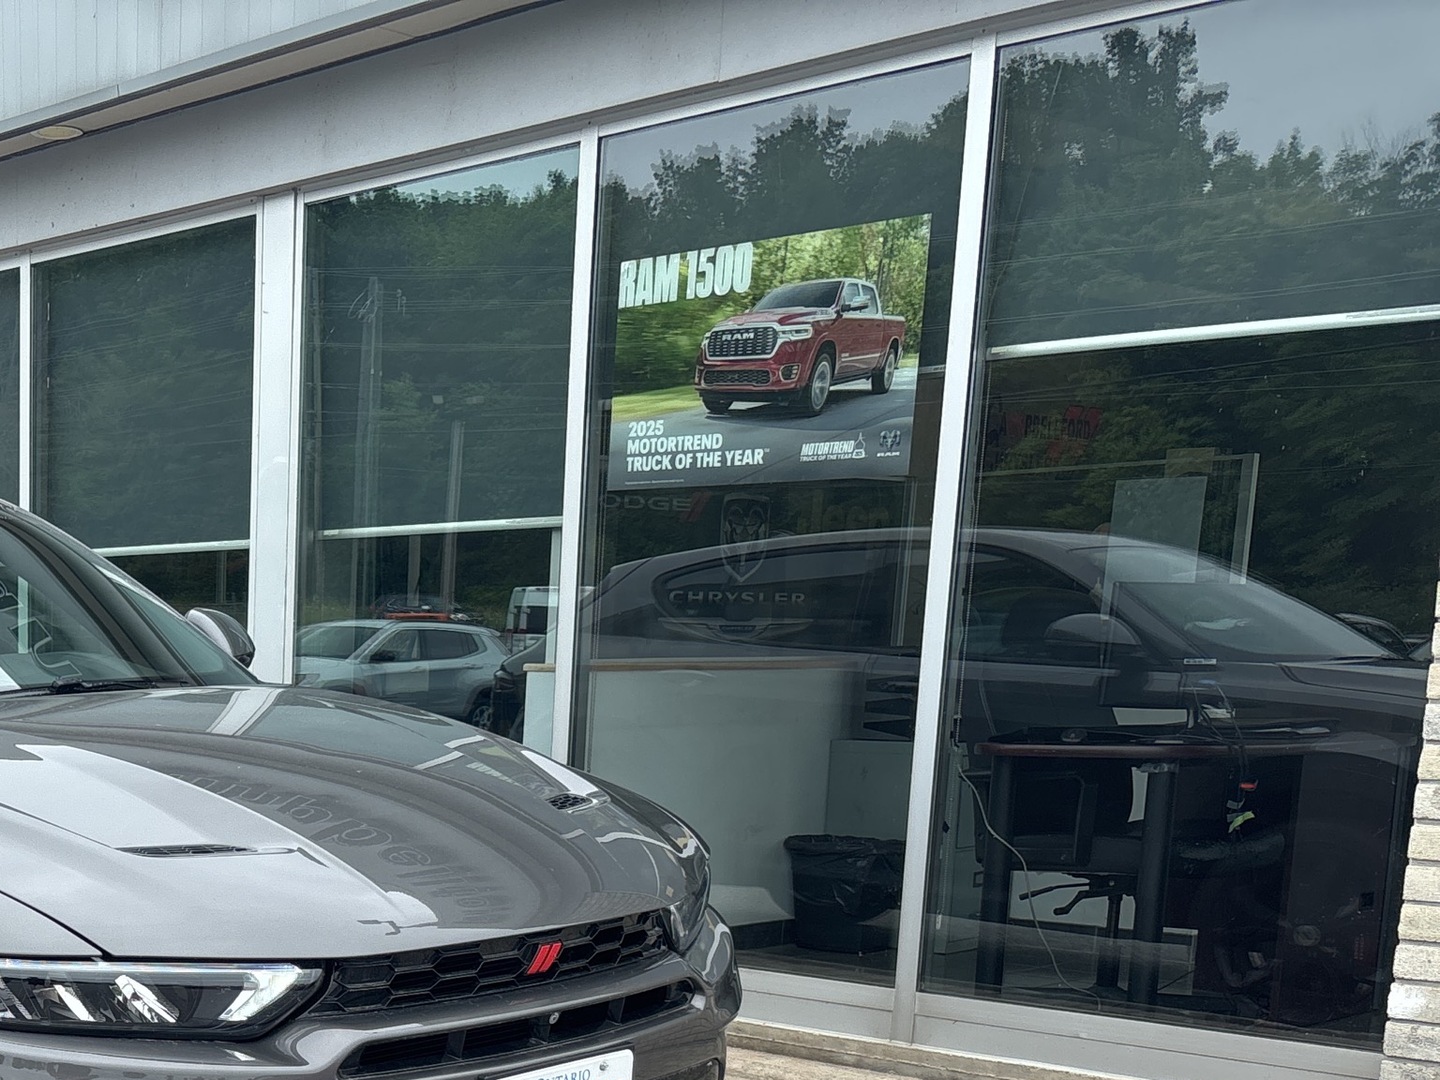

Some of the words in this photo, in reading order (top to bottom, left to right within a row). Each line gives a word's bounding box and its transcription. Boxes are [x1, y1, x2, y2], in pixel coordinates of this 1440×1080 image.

[618, 253, 680, 309] RAM
[686, 241, 754, 299] 1500
[721, 332, 755, 341] RAM
[628, 420, 664, 437] 2025
[626, 433, 723, 455] MOTORTREND
[800, 440, 855, 456] MOTORTREND
[626, 454, 672, 472] TRUCK
[675, 453, 693, 470] OF
[696, 451, 722, 468] THE
[725, 448, 764, 466] YEAR
[668, 590, 806, 604] CHRYSLER
